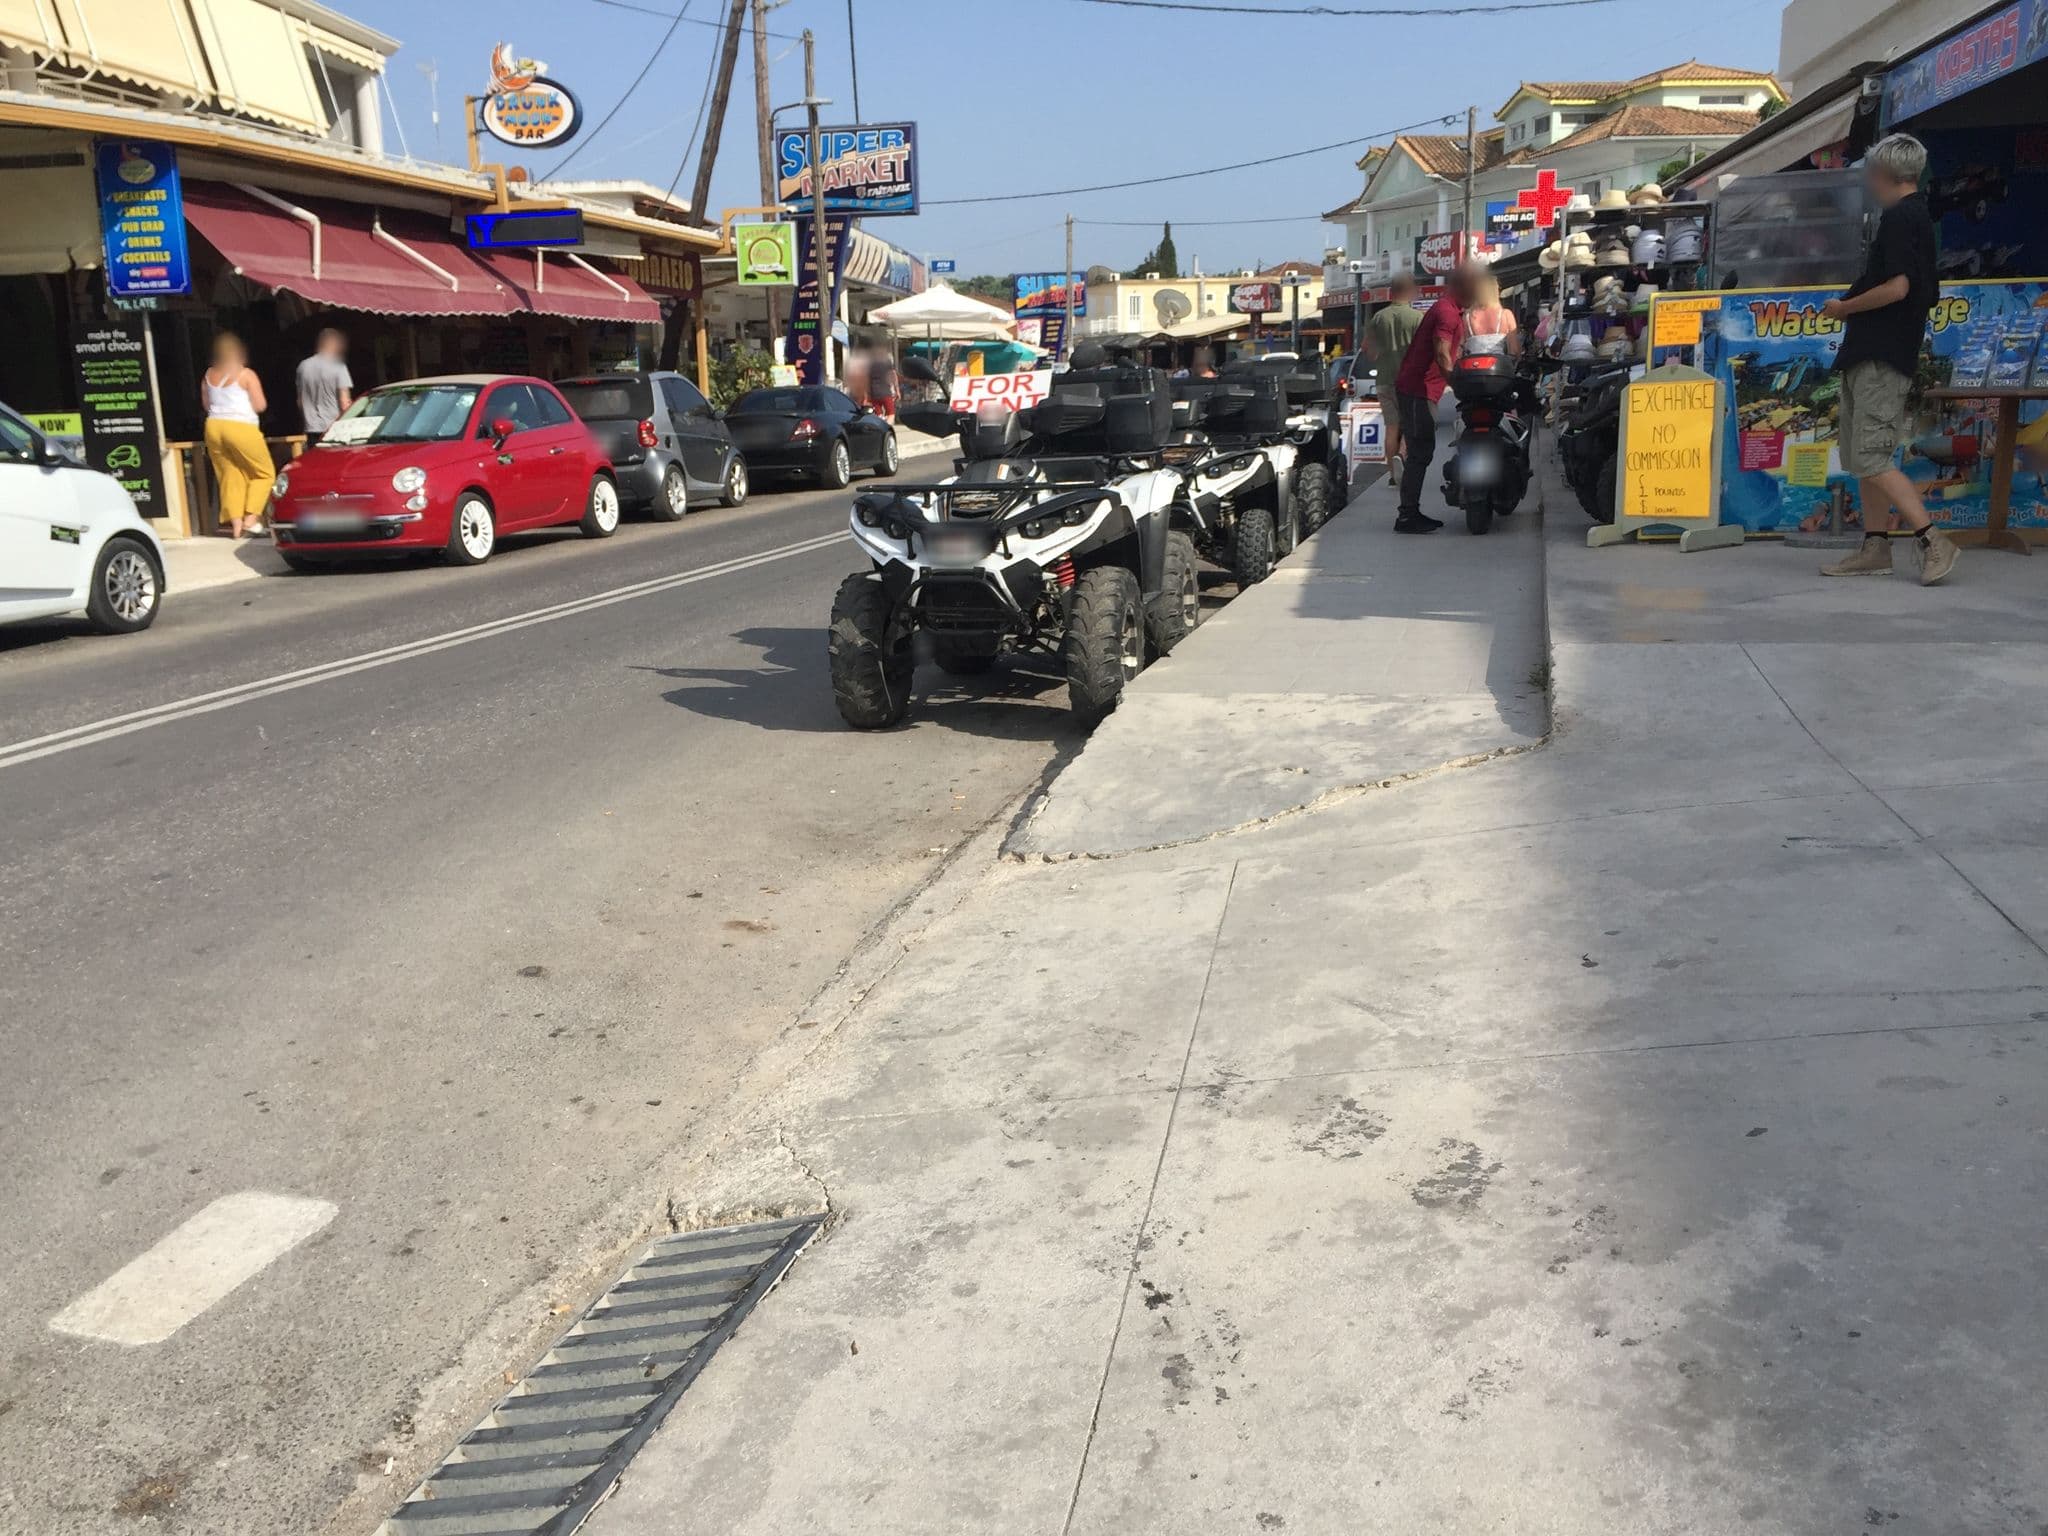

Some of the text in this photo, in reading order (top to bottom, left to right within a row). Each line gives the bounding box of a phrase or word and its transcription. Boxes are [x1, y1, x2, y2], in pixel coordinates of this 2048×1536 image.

[1936, 7, 2019, 88] KOSTAS
[495, 92, 559, 111] DRUNK
[515, 129, 545, 139] BAR
[781, 130, 904, 178] SUPER
[1421, 234, 1453, 255] Super
[1418, 252, 1455, 273] Market
[87, 329, 127, 340] make the
[75, 339, 142, 354] smart choice
[967, 374, 1034, 396] FOR
[1631, 383, 1715, 414] EXCHANGE
[1361, 426, 1376, 442] P
[1652, 423, 1677, 444] NO
[1626, 448, 1701, 471] COMMISSION
